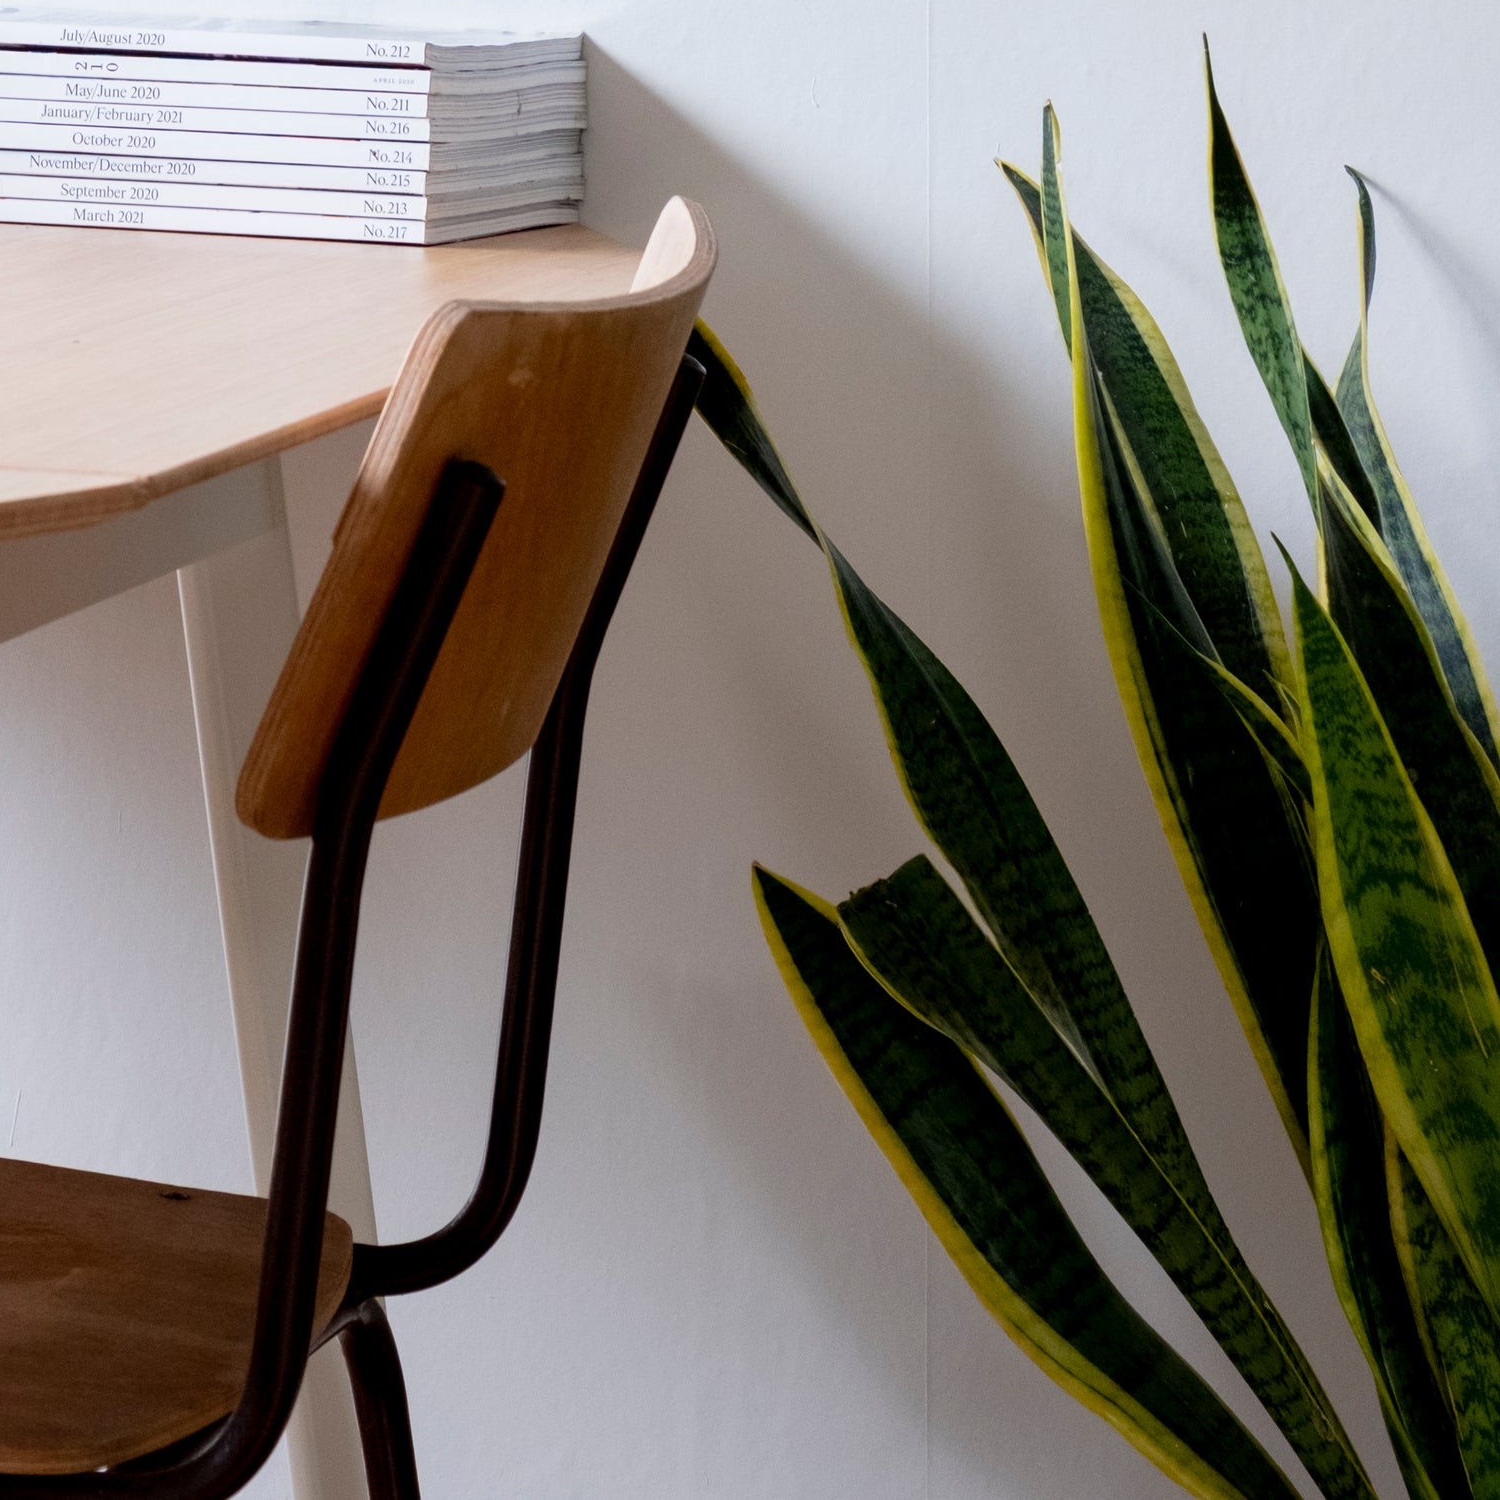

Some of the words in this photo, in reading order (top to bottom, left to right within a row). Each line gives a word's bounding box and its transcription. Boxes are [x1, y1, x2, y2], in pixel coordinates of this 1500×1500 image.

[60, 29, 132, 45] July/August
[136, 33, 165, 46] 2020
[366, 43, 410, 58] No.212
[65, 83, 127, 99] May/June
[130, 86, 160, 100] 2020
[367, 96, 409, 112] No.211
[41, 104, 153, 124] January/February
[157, 110, 182, 124] 2021
[365, 120, 410, 135] No.216
[72, 132, 123, 147] October
[126, 136, 156, 149] 2020
[368, 149, 412, 164] No.214
[29, 154, 163, 174] November/December
[166, 162, 196, 176] 2020
[366, 172, 410, 187] No.215
[61, 183, 126, 200] September
[130, 188, 159, 201] 2020
[364, 199, 408, 214] No.213
[73, 208, 115, 223] March
[118, 211, 144, 224] 2021
[363, 224, 408, 239] No.217
